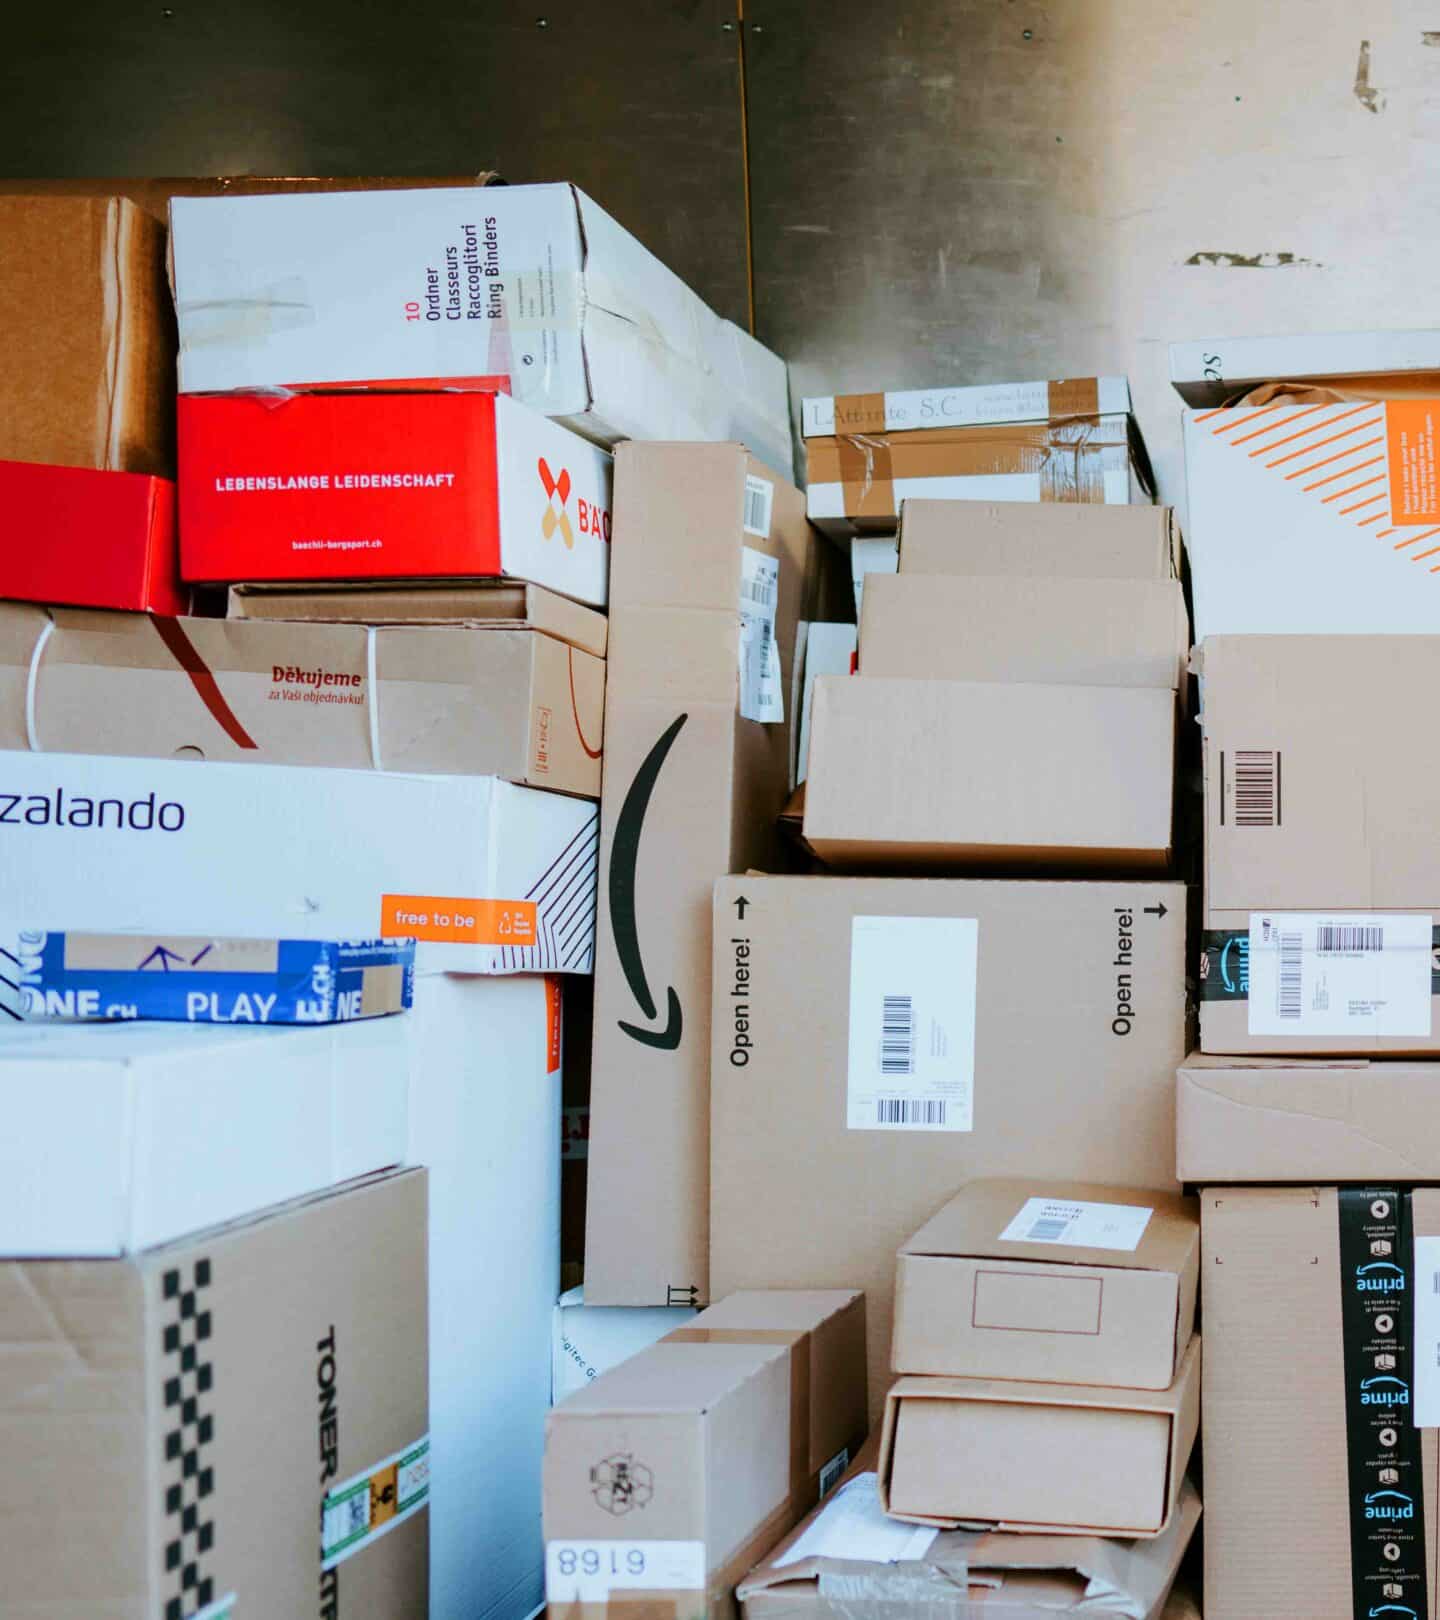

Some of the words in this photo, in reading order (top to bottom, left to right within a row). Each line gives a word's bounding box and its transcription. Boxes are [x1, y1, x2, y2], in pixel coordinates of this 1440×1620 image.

[483, 216, 499, 277] Binders
[425, 267, 441, 321] Ordner
[446, 246, 461, 321] Classeurs
[461, 224, 482, 320] Raccoglitori
[405, 302, 420, 321] 10
[487, 283, 504, 318] Ring
[216, 475, 329, 491] LEBENSLANGE
[334, 473, 456, 490] LEIDENSCHAFT
[272, 665, 361, 688] Děkujeme
[0, 787, 185, 832] zalando
[396, 910, 428, 925] free
[434, 912, 450, 927] to
[454, 913, 475, 928] be
[1113, 907, 1135, 966] here!
[730, 938, 751, 998] here!
[186, 991, 278, 1022] PLAY
[1112, 969, 1137, 1036] Open
[730, 1005, 754, 1068] Open
[1357, 1278, 1405, 1294] prime
[317, 1324, 338, 1485] TONER
[1360, 1389, 1409, 1408] prime
[1364, 1503, 1413, 1522] prime
